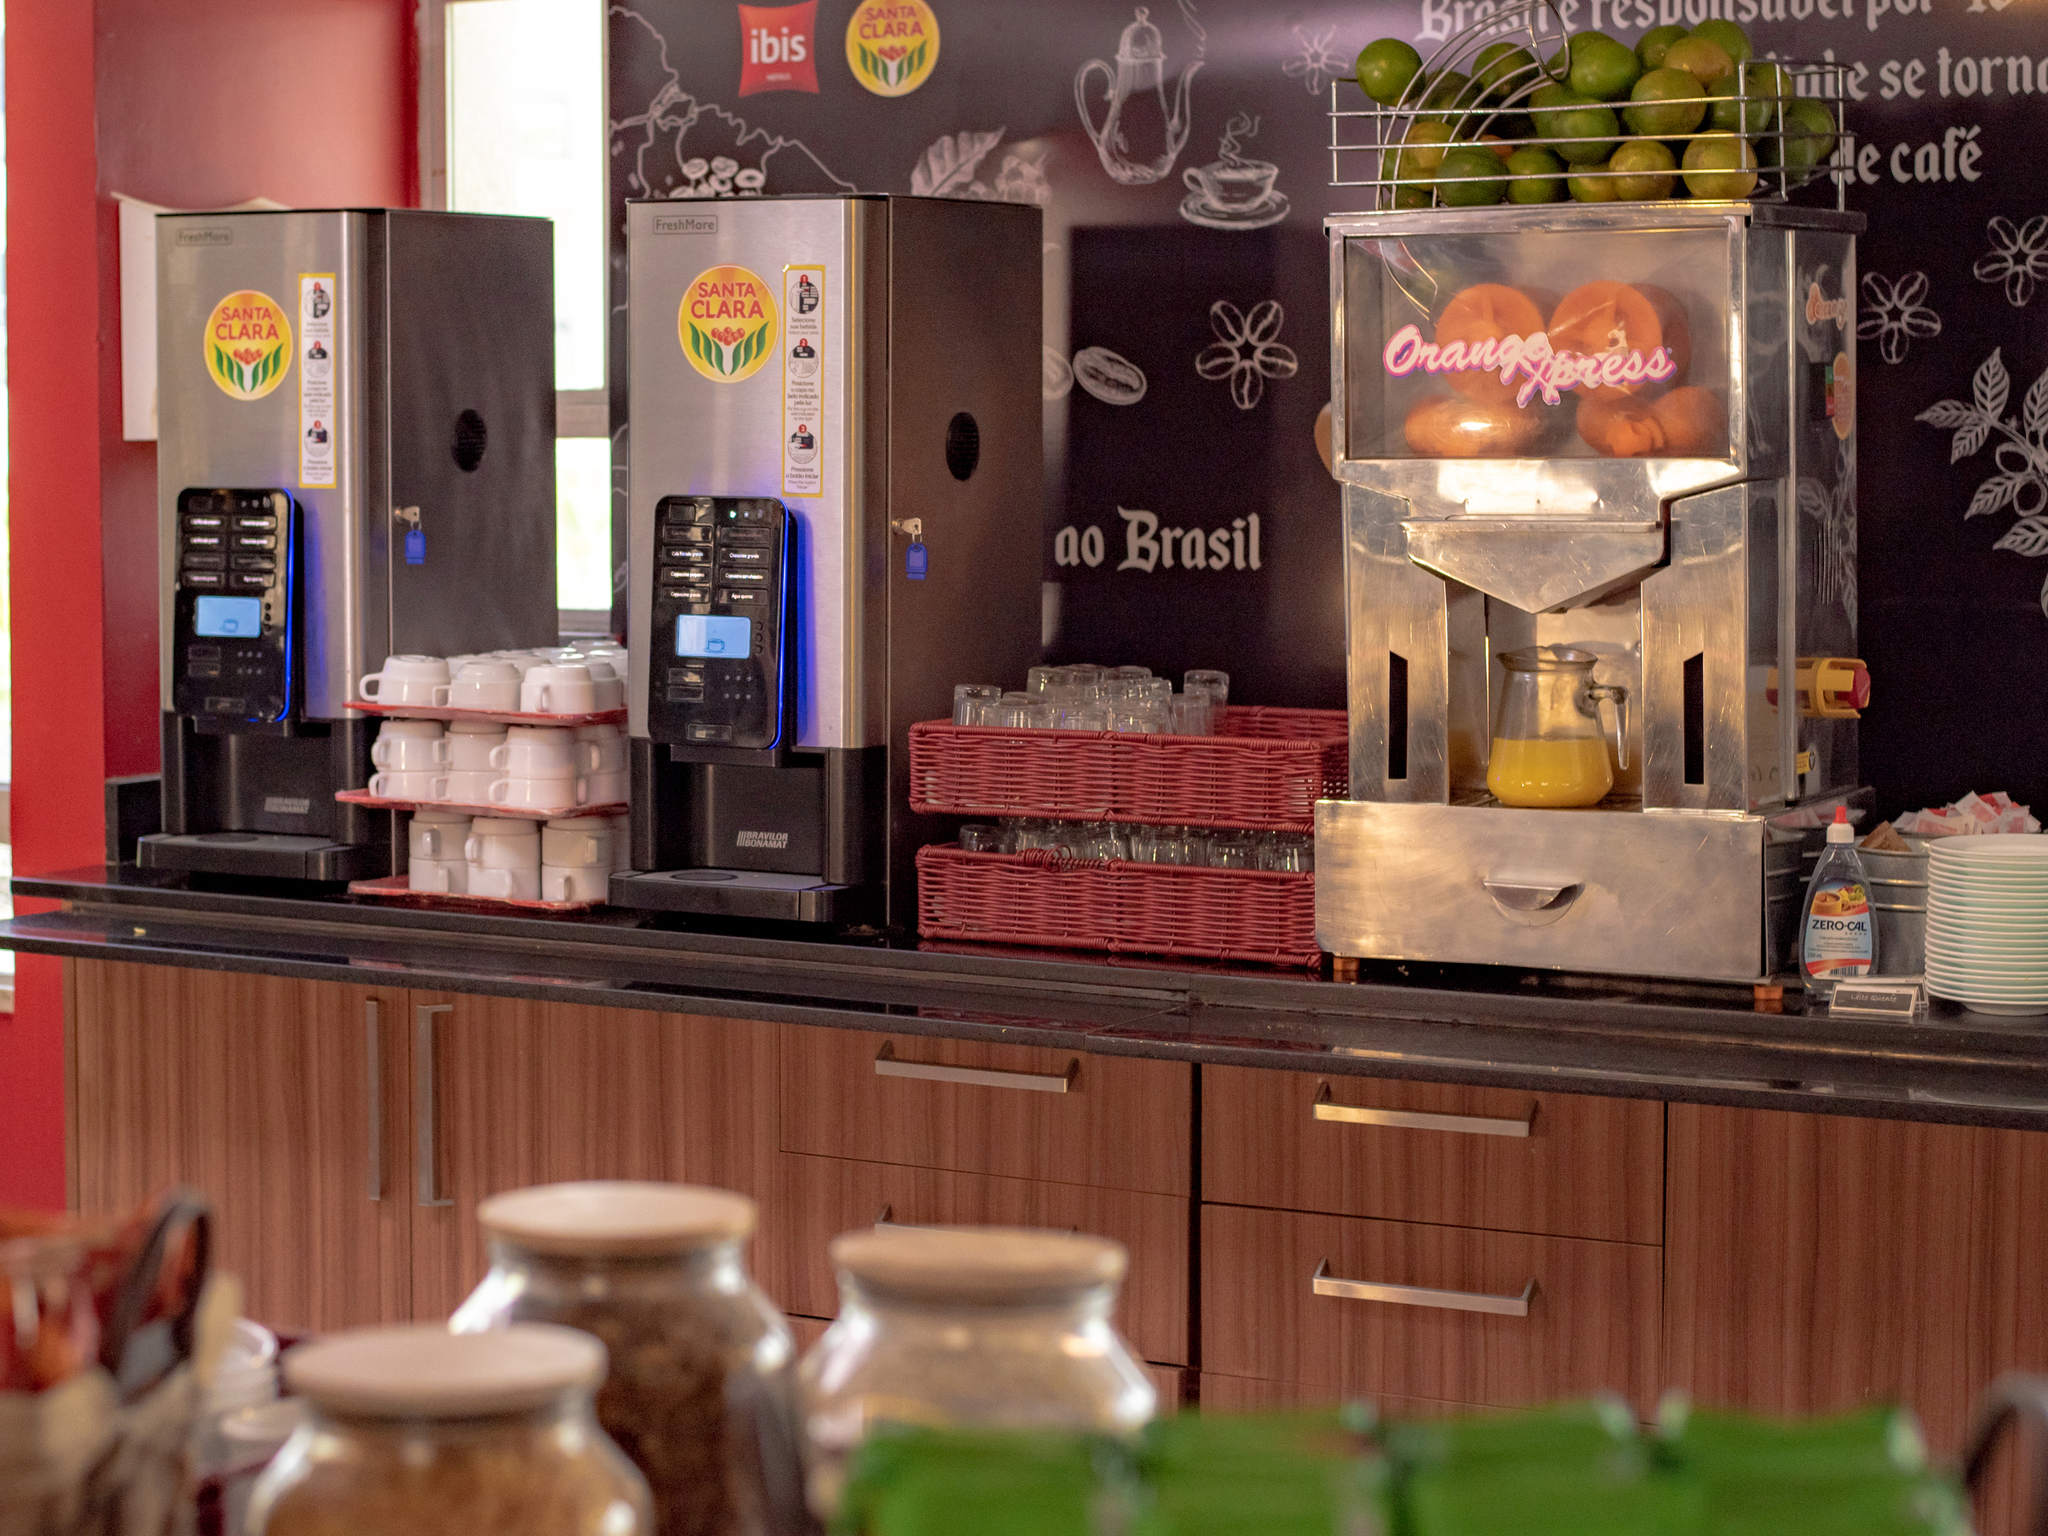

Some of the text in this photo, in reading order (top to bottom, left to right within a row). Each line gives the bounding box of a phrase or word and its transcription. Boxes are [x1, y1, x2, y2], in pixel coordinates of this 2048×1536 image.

[865, 6, 917, 21] SANTA
[859, 21, 924, 39] CLARA
[750, 27, 807, 64] ibis
[1879, 58, 1926, 100] se
[1829, 124, 1983, 185] de café
[656, 219, 715, 231] FreshMore
[698, 282, 757, 298] SANTA
[221, 307, 272, 322] SANTA
[691, 300, 764, 319] CLARA
[215, 323, 279, 340] CLARA
[1055, 505, 1262, 573] ao Brasil
[744, 831, 789, 840] BRAVILOR
[1812, 919, 1868, 932] ZERO-CAL
